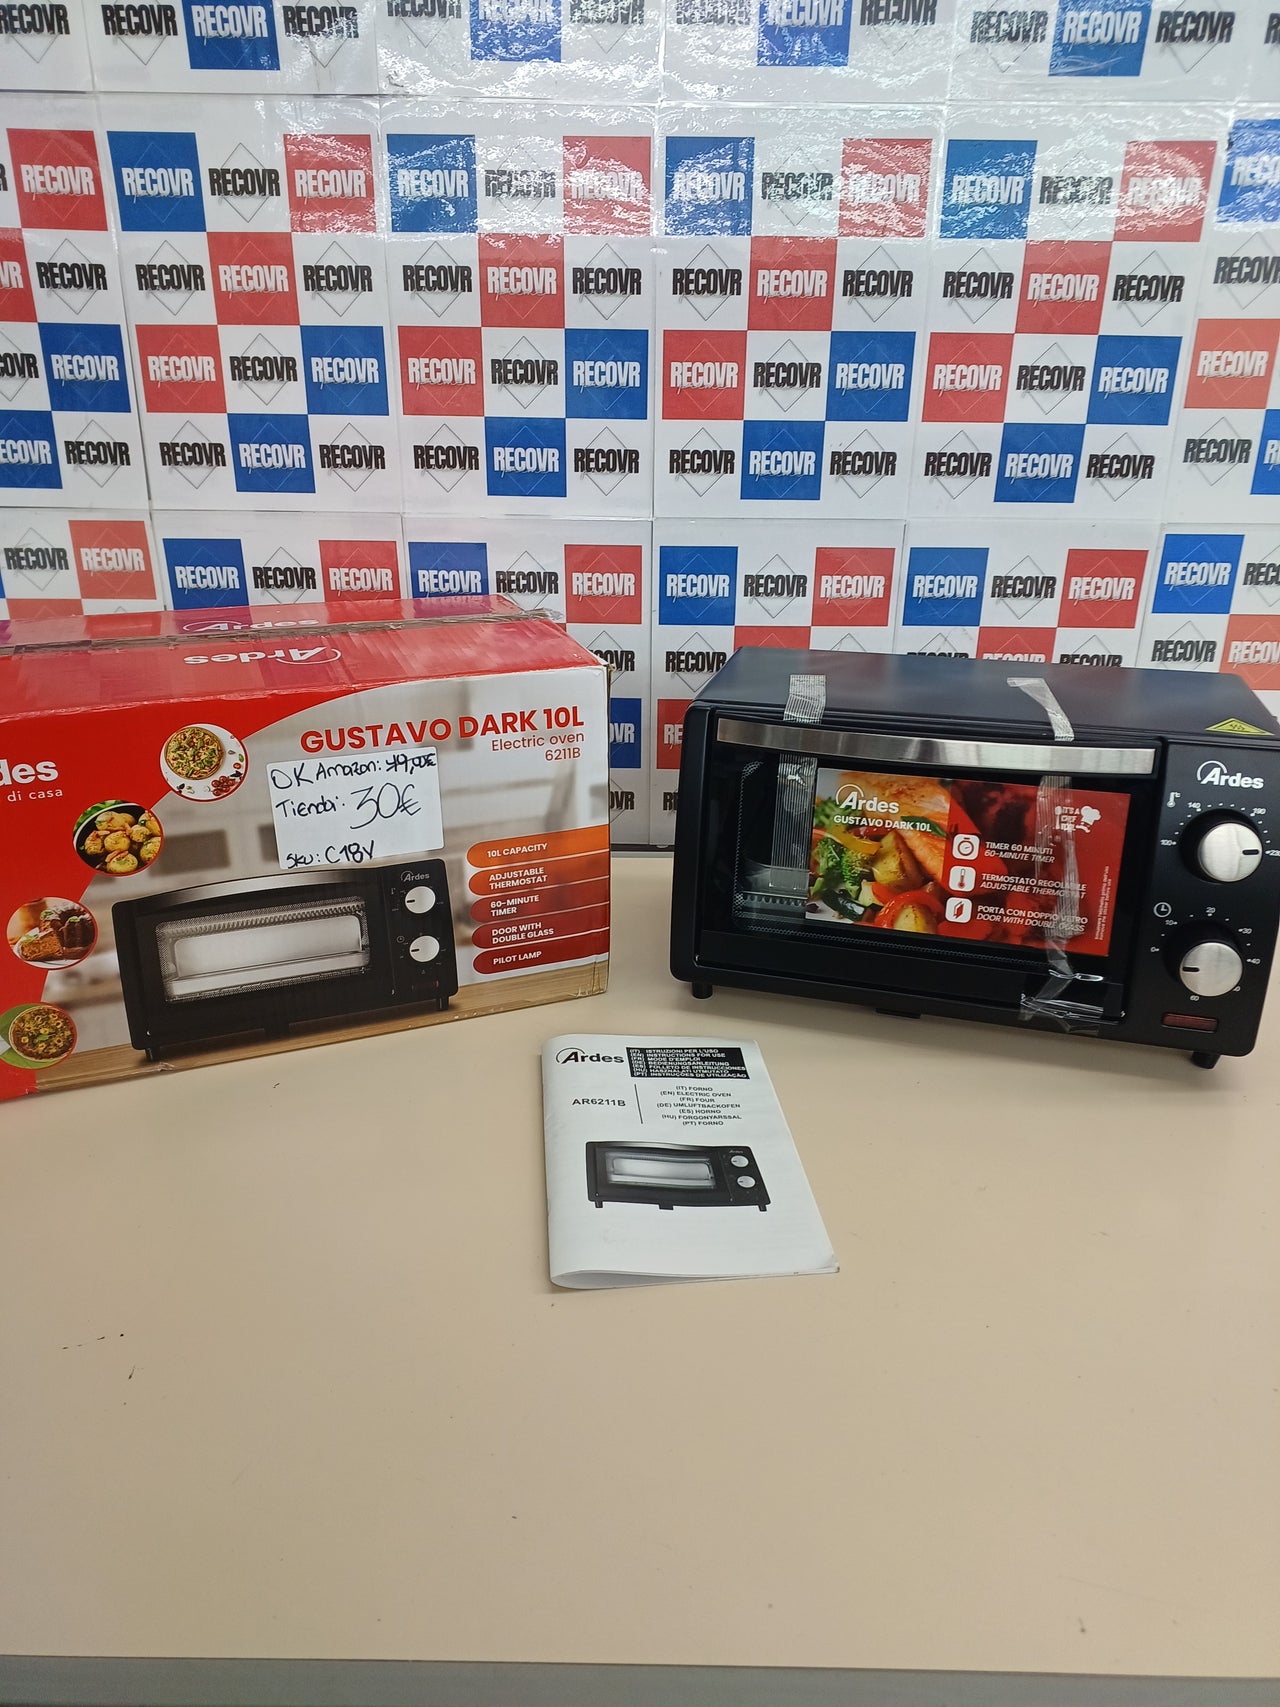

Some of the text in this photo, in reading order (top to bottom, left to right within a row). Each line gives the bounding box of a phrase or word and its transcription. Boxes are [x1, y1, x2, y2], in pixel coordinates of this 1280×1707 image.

[0, 3, 70, 35] RECOVR
[104, 4, 178, 36] RECOVR
[192, 5, 268, 38] RECOVR
[1062, 11, 1142, 44] RECOVR
[1155, 11, 1235, 43] RECOVR
[21, 164, 95, 195] RECOVR
[122, 168, 194, 196] RECOVR
[209, 168, 280, 196] RECOVR
[295, 170, 366, 197] RECOVR
[398, 169, 469, 199] RECOVR
[36, 262, 107, 290] RECOVR
[136, 264, 205, 291] RECOVR
[219, 265, 288, 292] RECOVR
[303, 265, 372, 292] RECOVR
[403, 265, 472, 292] RECOVR
[487, 267, 557, 294] RECOVR
[572, 268, 641, 295] RECOVR
[672, 269, 742, 296] RECOVR
[757, 270, 827, 297] RECOVR
[842, 270, 913, 297] RECOVR
[943, 272, 1014, 299] RECOVR
[1112, 275, 1185, 302] RECOVR
[51, 354, 119, 380] RECOVR
[147, 356, 216, 381] RECOVR
[229, 356, 298, 381] RECOVR
[311, 358, 379, 383] RECOVR
[491, 359, 559, 385] RECOVR
[573, 361, 641, 387] RECOVR
[670, 361, 739, 388] RECOVR
[753, 362, 822, 388] RECOVR
[835, 363, 905, 389] RECOVR
[1197, 351, 1269, 377] RECOVR
[1016, 365, 1086, 391] RECOVR
[0, 440, 52, 464] ECOVR
[64, 441, 131, 466] RECOVR
[159, 442, 226, 467] RECOVR
[239, 444, 306, 468] RECOVR
[413, 445, 479, 470] RECOVR
[493, 447, 559, 472] RECOVR
[669, 450, 735, 474] RECOVR
[749, 451, 816, 475] RECOVR
[1184, 439, 1252, 463] RECOVR
[829, 452, 897, 476] RECOVR
[1086, 455, 1155, 479] RECOVR
[4, 547, 69, 570] RECOVR
[80, 548, 145, 571] RECOVR
[174, 566, 240, 589] RECOVR
[252, 567, 316, 589] RECOVR
[328, 568, 393, 591] RECOVR
[496, 571, 559, 594] RECOVR
[572, 572, 635, 596] RECOVR
[744, 574, 808, 597] RECOVR
[1164, 562, 1232, 585] RECOVR
[821, 576, 886, 598] RECOVR
[184, 646, 341, 664] Ardes
[665, 652, 727, 672] RECOVR
[1152, 640, 1217, 662] RECOVR
[300, 706, 584, 752] GUSTAVO DARK 10L
[492, 732, 584, 751] Electric oven
[545, 748, 581, 761] 6211B
[0, 759, 58, 786] des
[271, 762, 313, 789] OK
[1197, 761, 1264, 788] Ardes
[7, 789, 63, 801] di casa
[350, 782, 421, 829] 30€
[836, 784, 899, 813] Ardes
[833, 815, 932, 832] GUSTAVO DARK 10L
[503, 843, 547, 856] CAPACITY
[984, 850, 1055, 863] 60-MINUTE TIMER
[985, 841, 1009, 850] TIMER
[1011, 843, 1022, 851] 60
[401, 870, 429, 882] Ardes
[489, 867, 544, 881] ADJUSTABLE
[489, 875, 547, 890] THERMOSTAT
[981, 873, 1037, 886] TERMOSTATO
[980, 881, 1029, 893] ADJUSTABLE
[490, 895, 539, 908] 60-MINUTE
[490, 907, 517, 917] TIMER
[978, 905, 1004, 915] PORTA
[1007, 908, 1025, 917] CON
[1027, 910, 1057, 921] DOPPIO
[492, 922, 542, 936] DOOR WITH
[976, 913, 1001, 922] DOOR
[1003, 915, 1024, 925] WITH
[492, 928, 554, 944] DOUBLE GLASS
[493, 951, 542, 964] PILOT LAMP
[556, 1047, 624, 1064] Ardes
[572, 1098, 626, 1107] AR6211B
